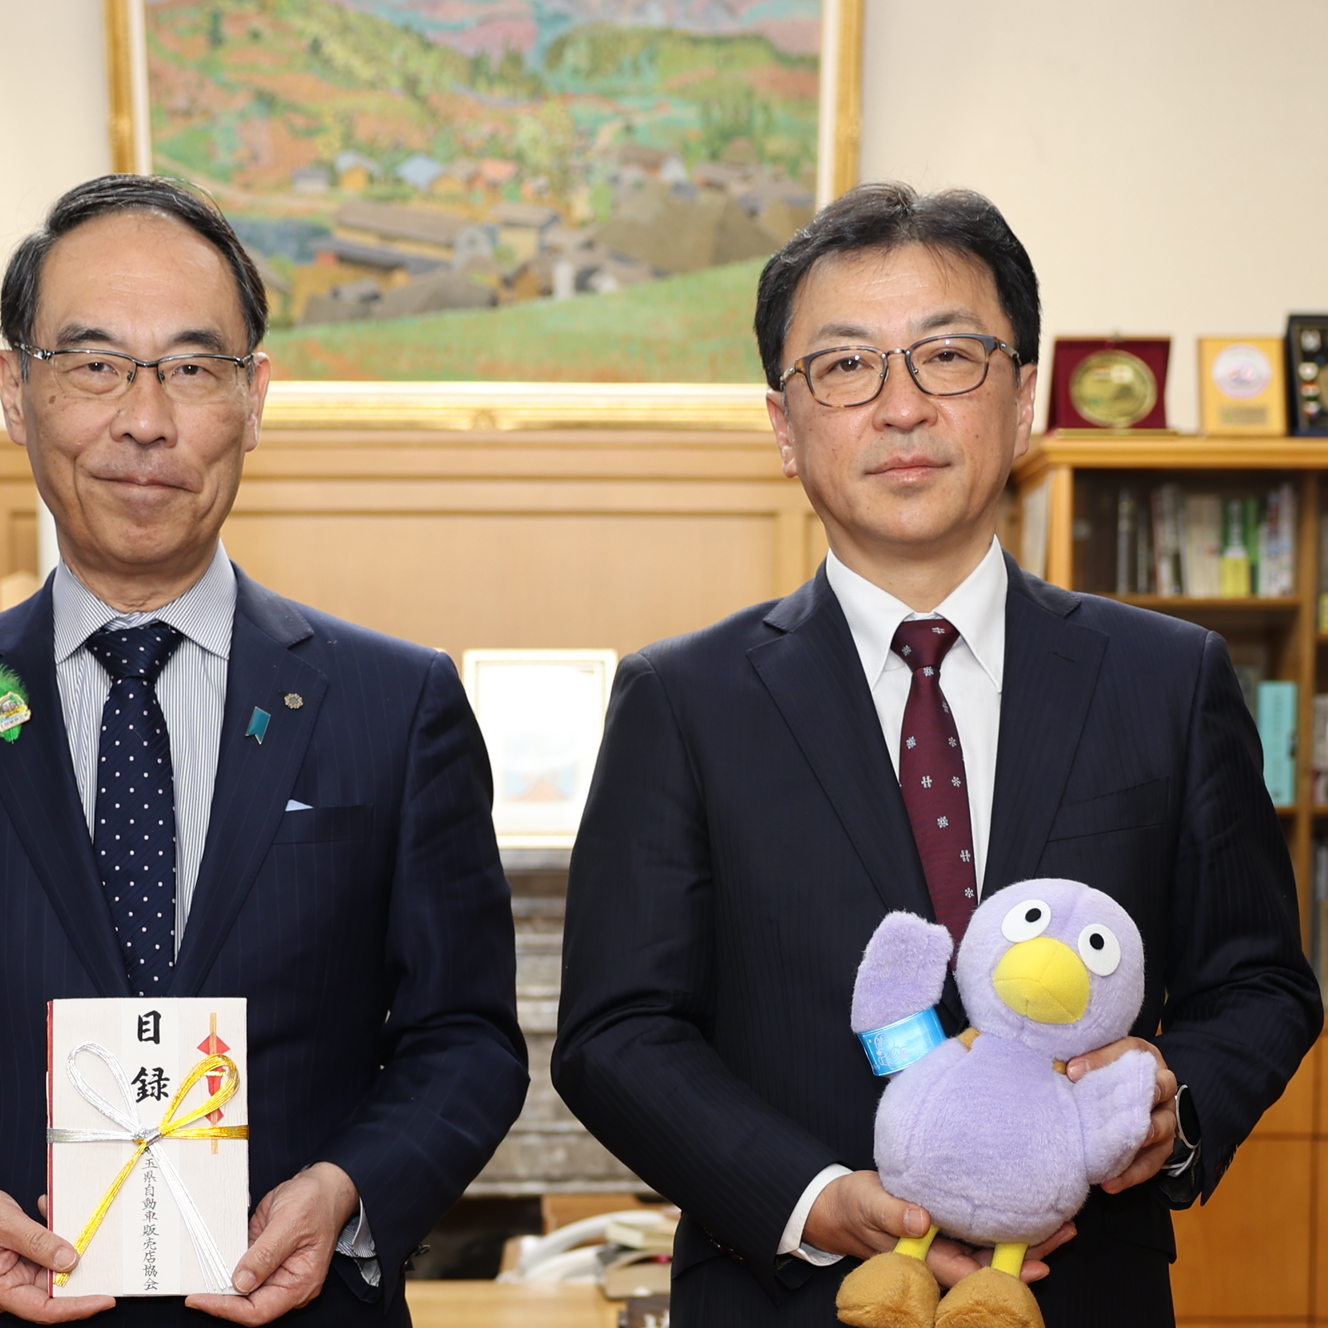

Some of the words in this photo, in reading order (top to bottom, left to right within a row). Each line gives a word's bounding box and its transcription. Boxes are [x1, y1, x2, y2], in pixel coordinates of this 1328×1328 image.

[130, 1010, 171, 1104] 目録
[141, 1146, 160, 1291] 玉県自動車販売店協会
